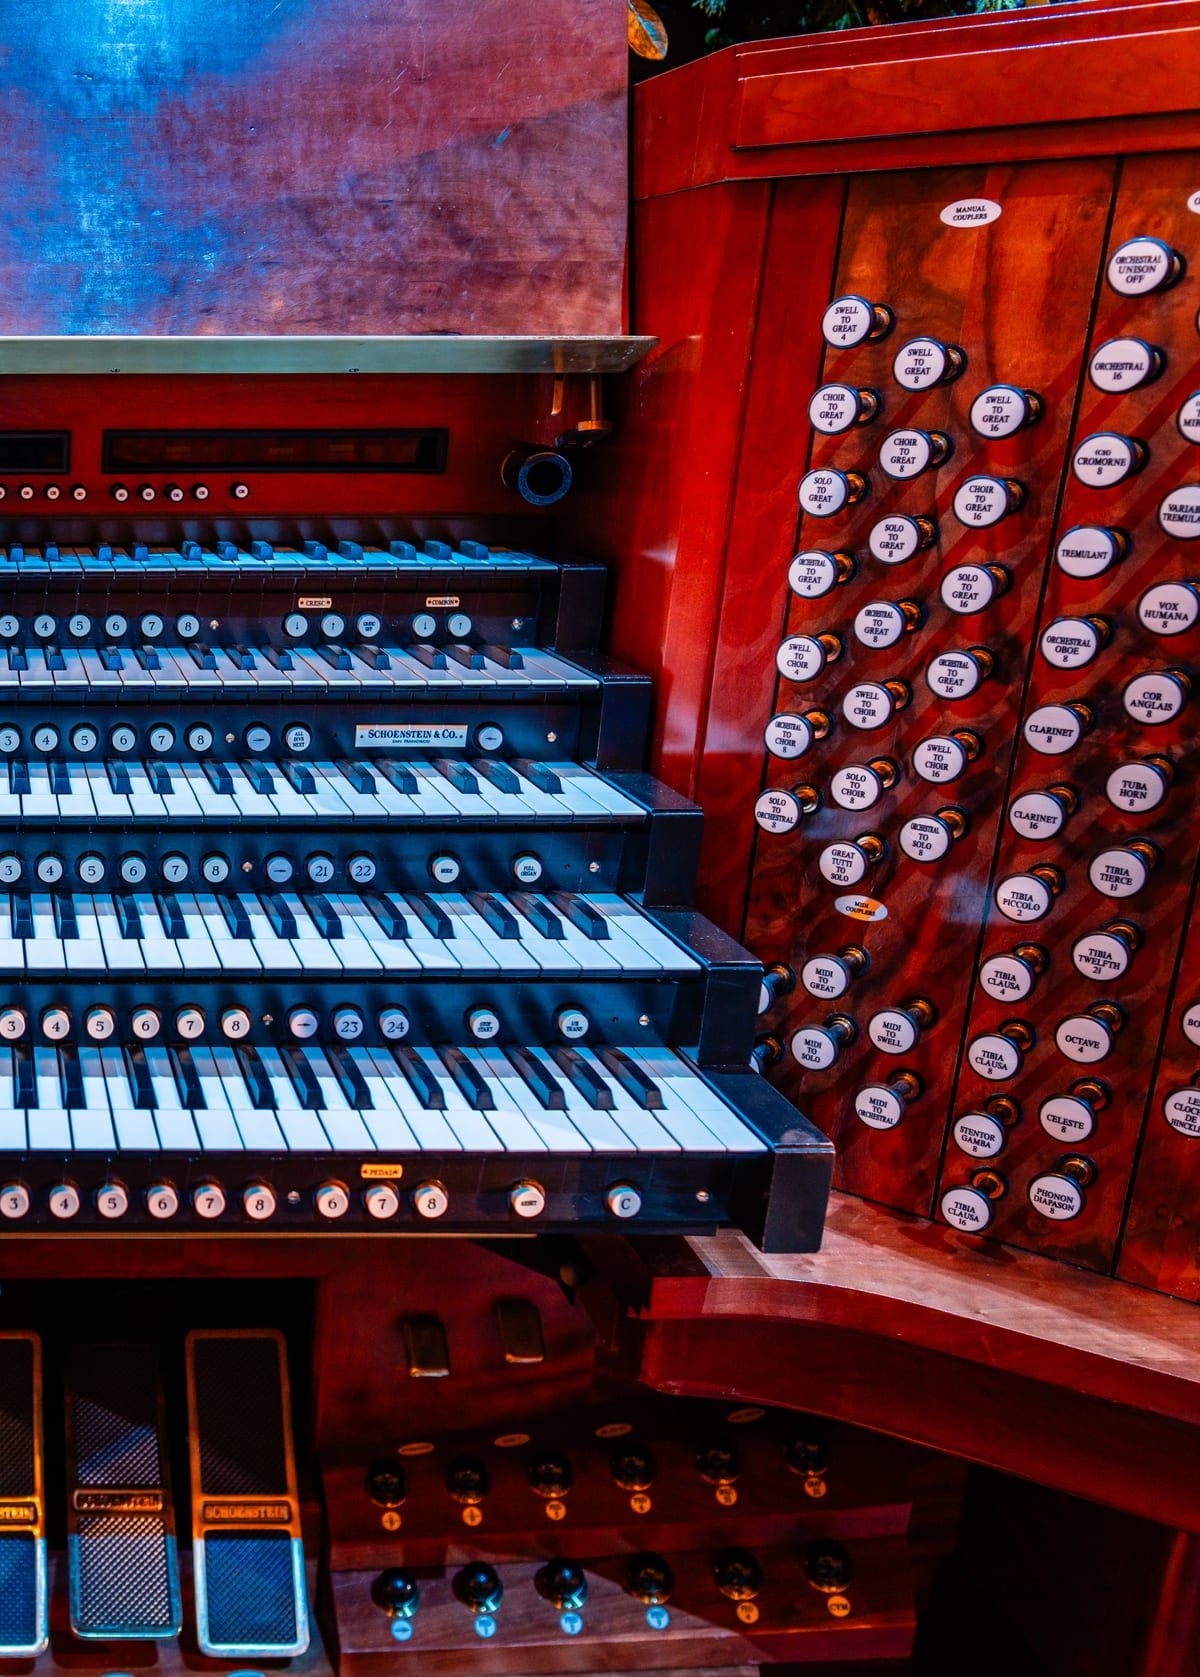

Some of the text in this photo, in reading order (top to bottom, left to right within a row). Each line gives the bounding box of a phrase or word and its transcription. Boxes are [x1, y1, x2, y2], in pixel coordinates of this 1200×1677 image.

[955, 205, 986, 214] MANUAL
[952, 212, 988, 221] COUPLERS
[1115, 256, 1162, 265] ORCHESTRAL
[1118, 265, 1157, 275] UNISON
[1126, 274, 1144, 284] OFF
[835, 306, 859, 315] SWELL
[832, 324, 857, 333] GREAT
[840, 333, 846, 341] 4
[1077, 457, 1127, 467] CROMORNE
[1097, 467, 1102, 475] 8
[1061, 549, 1108, 559] TREMULANT
[1158, 601, 1179, 612] VOX
[1144, 609, 1189, 622] HUMANA
[1162, 620, 1168, 628] 8
[1046, 635, 1092, 648] ORCHESTRAL
[1055, 644, 1079, 655] OBOE
[1063, 655, 1069, 663] 8
[368, 729, 432, 738] SCHOENSTEIN
[1029, 724, 1074, 737] CLARINET
[1047, 735, 1052, 743] 8
[1122, 780, 1148, 791] TUBA
[1120, 788, 1147, 800] HORN
[1128, 798, 1135, 806] 8
[315, 865, 328, 876] 21
[356, 865, 371, 876] 22
[1011, 890, 1034, 901] TIBIA
[1003, 897, 1041, 912] PICCOLO
[1016, 908, 1023, 917] 2
[815, 968, 834, 979] MIDI
[819, 975, 829, 983] TO
[994, 969, 1017, 981] TIBIA
[810, 981, 836, 994] GREAT
[987, 977, 1021, 991] CLAUSA
[341, 1021, 358, 1032] 23
[388, 1021, 404, 1032] 24
[1065, 1034, 1100, 1049] OCTAVE
[1078, 1045, 1084, 1053] 4
[1046, 1113, 1084, 1129] CELESTE
[959, 1125, 995, 1142] STENTOR
[1060, 1125, 1067, 1133] 8
[961, 1135, 991, 1148] GAMBA
[972, 1145, 978, 1153] 8
[1036, 1187, 1074, 1204] PHONON
[621, 1197, 631, 1210] C
[1033, 1195, 1075, 1212] DIAPASON
[1049, 1207, 1055, 1215] 8
